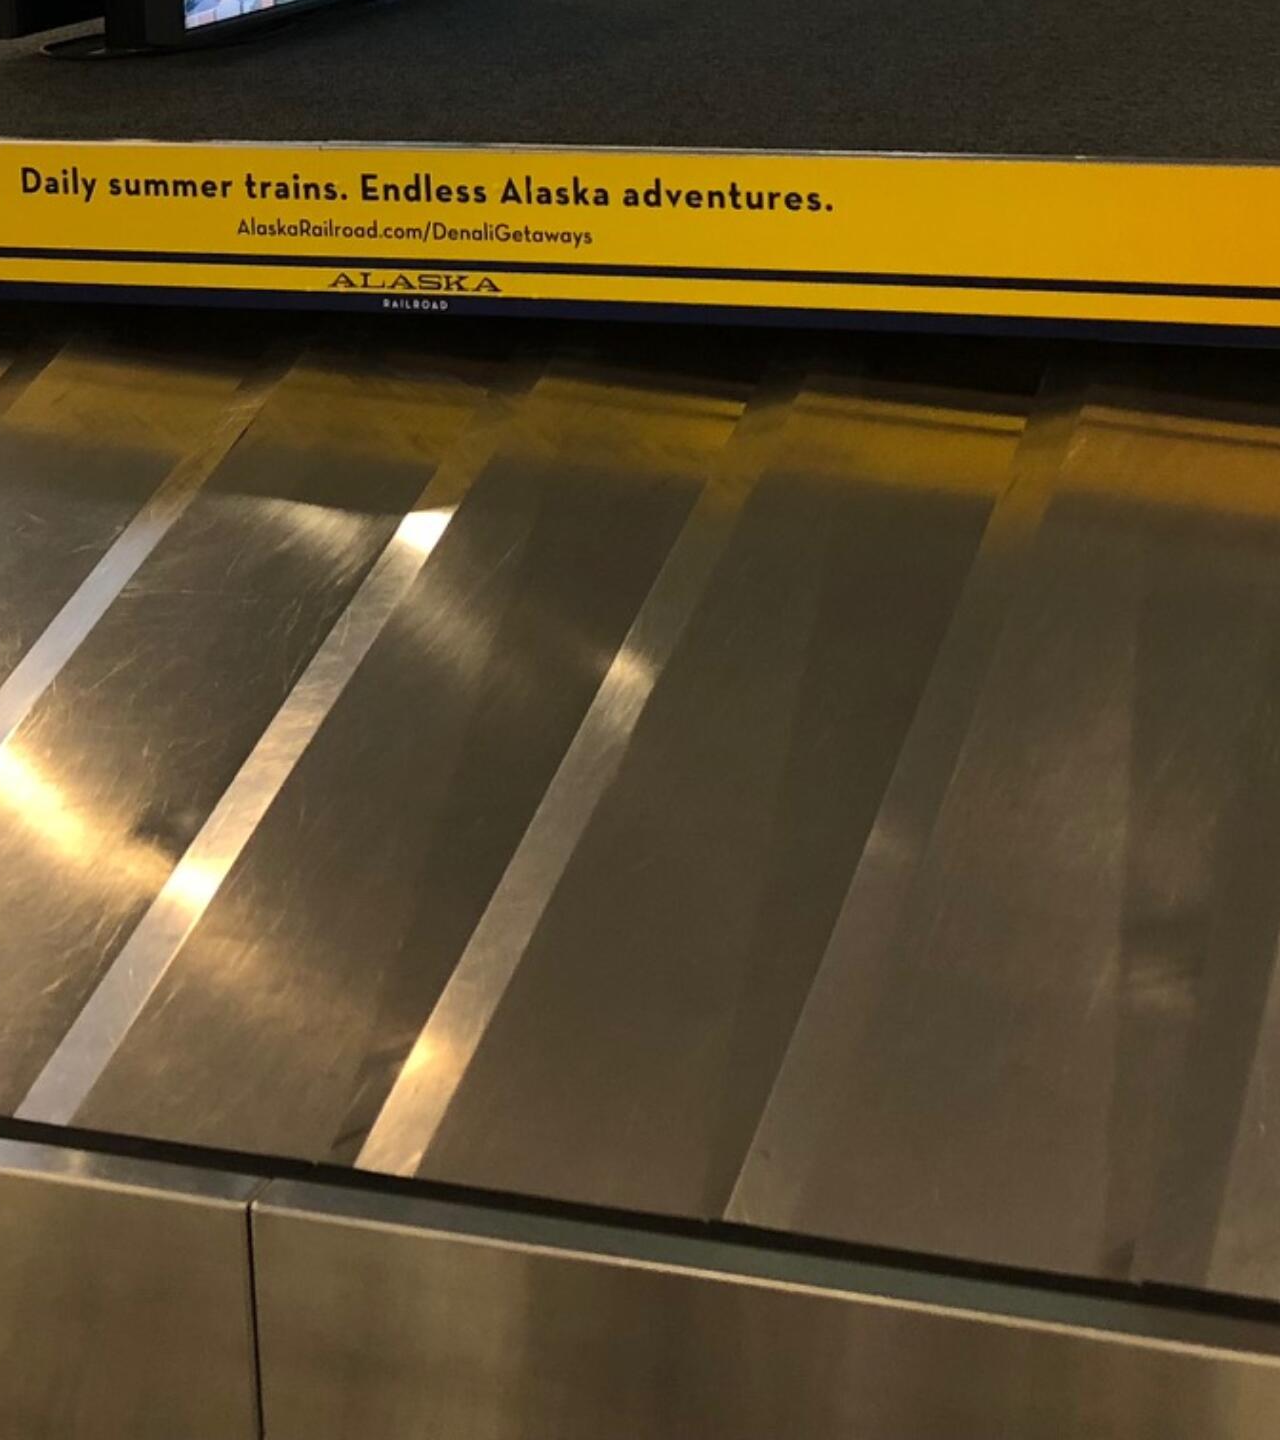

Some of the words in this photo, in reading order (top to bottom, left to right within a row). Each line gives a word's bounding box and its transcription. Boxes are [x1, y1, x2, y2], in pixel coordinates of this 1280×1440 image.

[21, 166, 97, 203] Daily
[109, 175, 233, 198] summer
[245, 173, 348, 201] trains.
[361, 173, 487, 203] Endless
[500, 176, 610, 206] Alaska
[623, 178, 833, 212] adventures.
[237, 218, 593, 248] AlaskaRailroad.com/DenaliGetaways
[328, 271, 503, 293] ALASKA
[382, 298, 449, 311] RAILROAD
